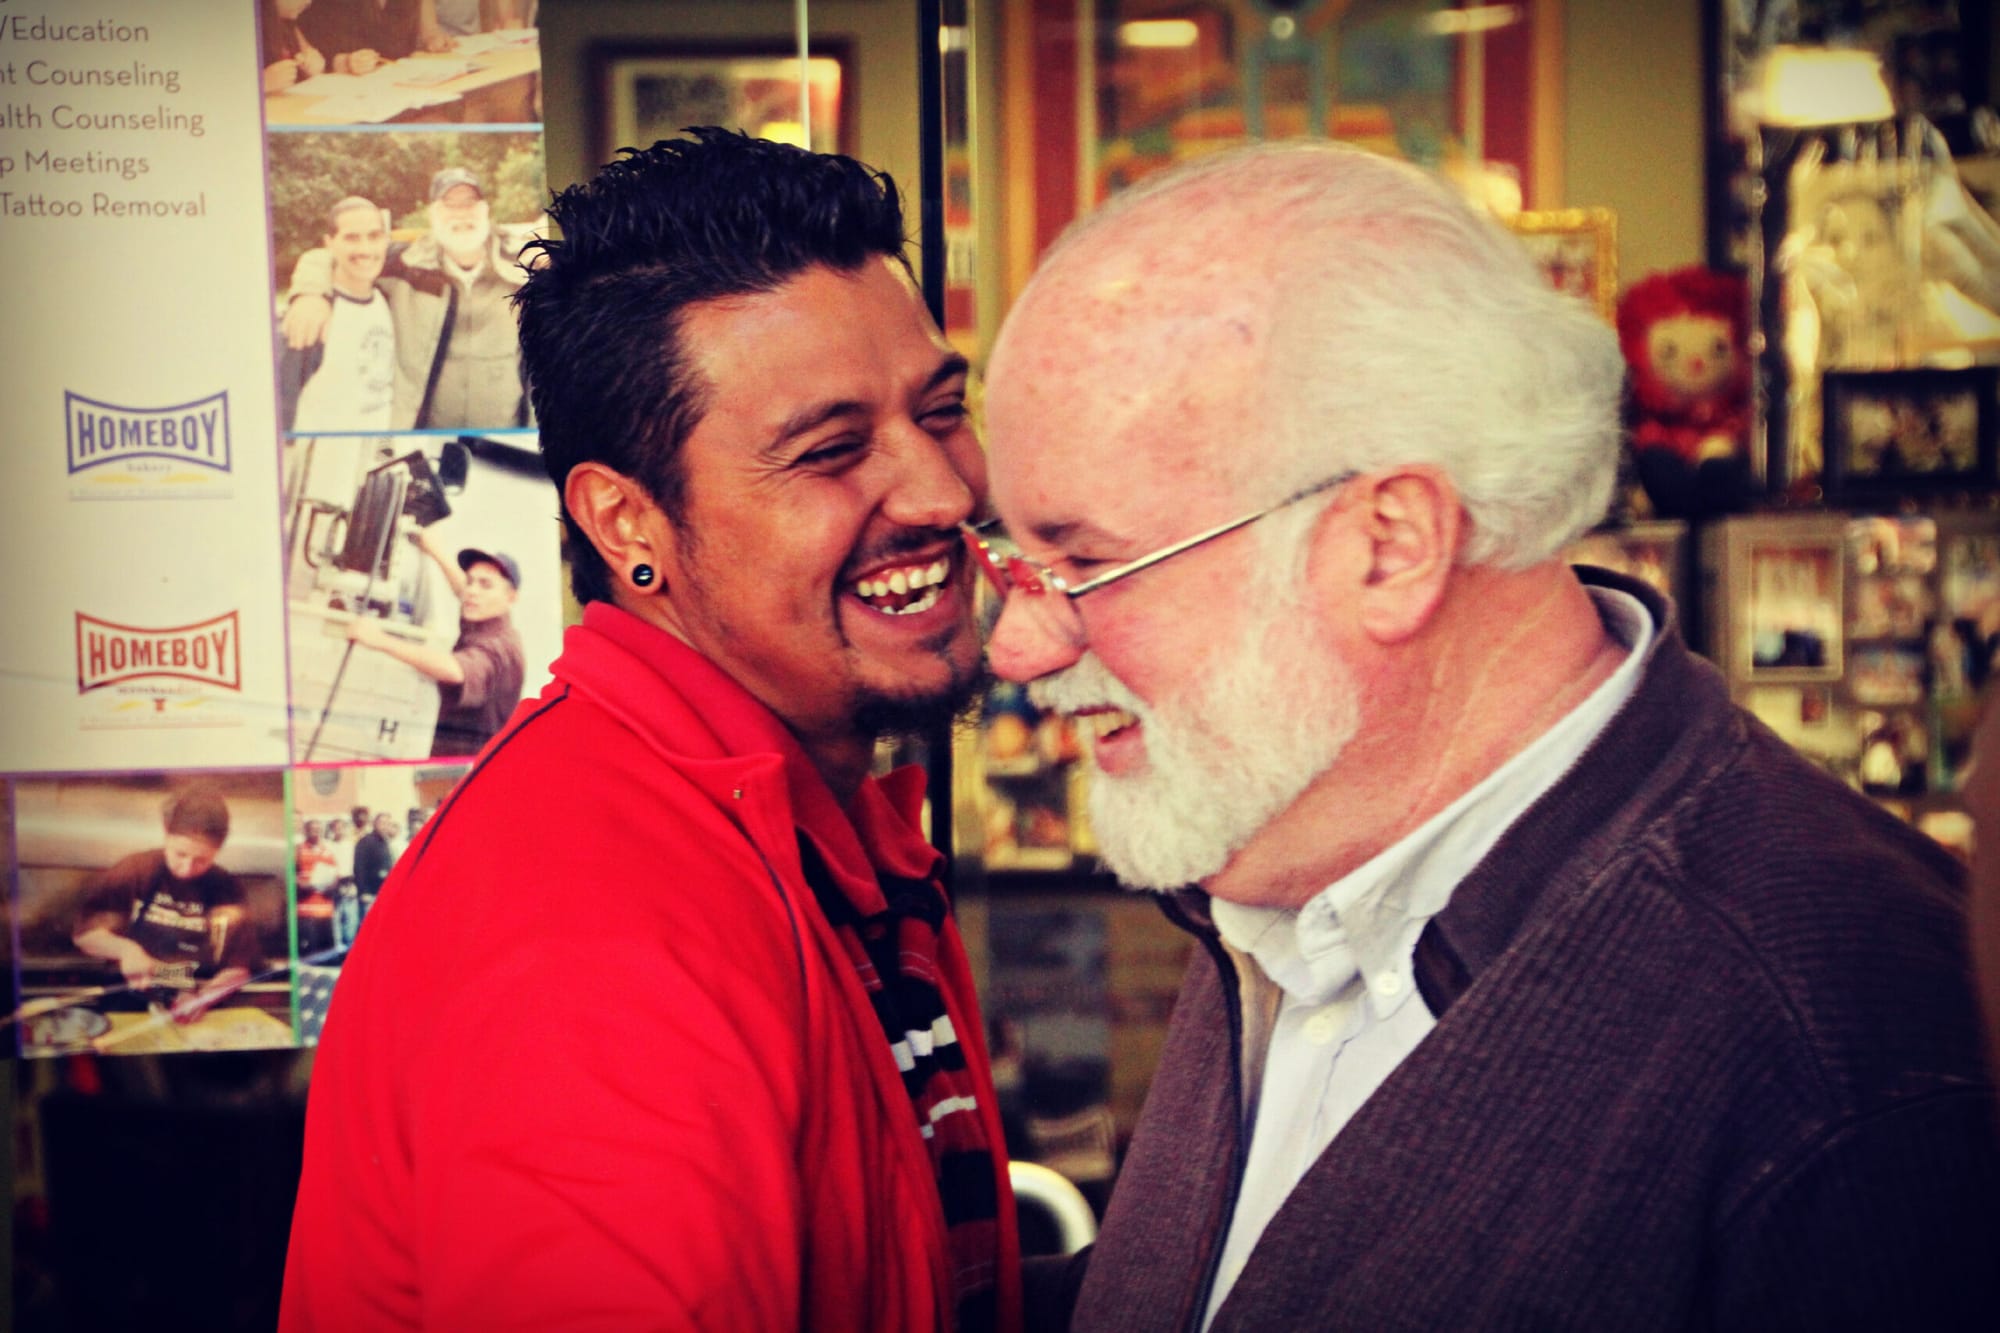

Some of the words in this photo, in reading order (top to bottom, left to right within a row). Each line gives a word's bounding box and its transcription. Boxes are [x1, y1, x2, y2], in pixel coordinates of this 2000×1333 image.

[0, 15, 149, 42] /Education
[26, 59, 181, 93] Counseling
[51, 105, 206, 137] Counseling
[25, 149, 150, 181] Meetings
[0, 192, 82, 217] Tattoo
[93, 192, 207, 217] Removal
[77, 409, 217, 457] HOMEBOY
[88, 629, 227, 677] HOMEBOY
